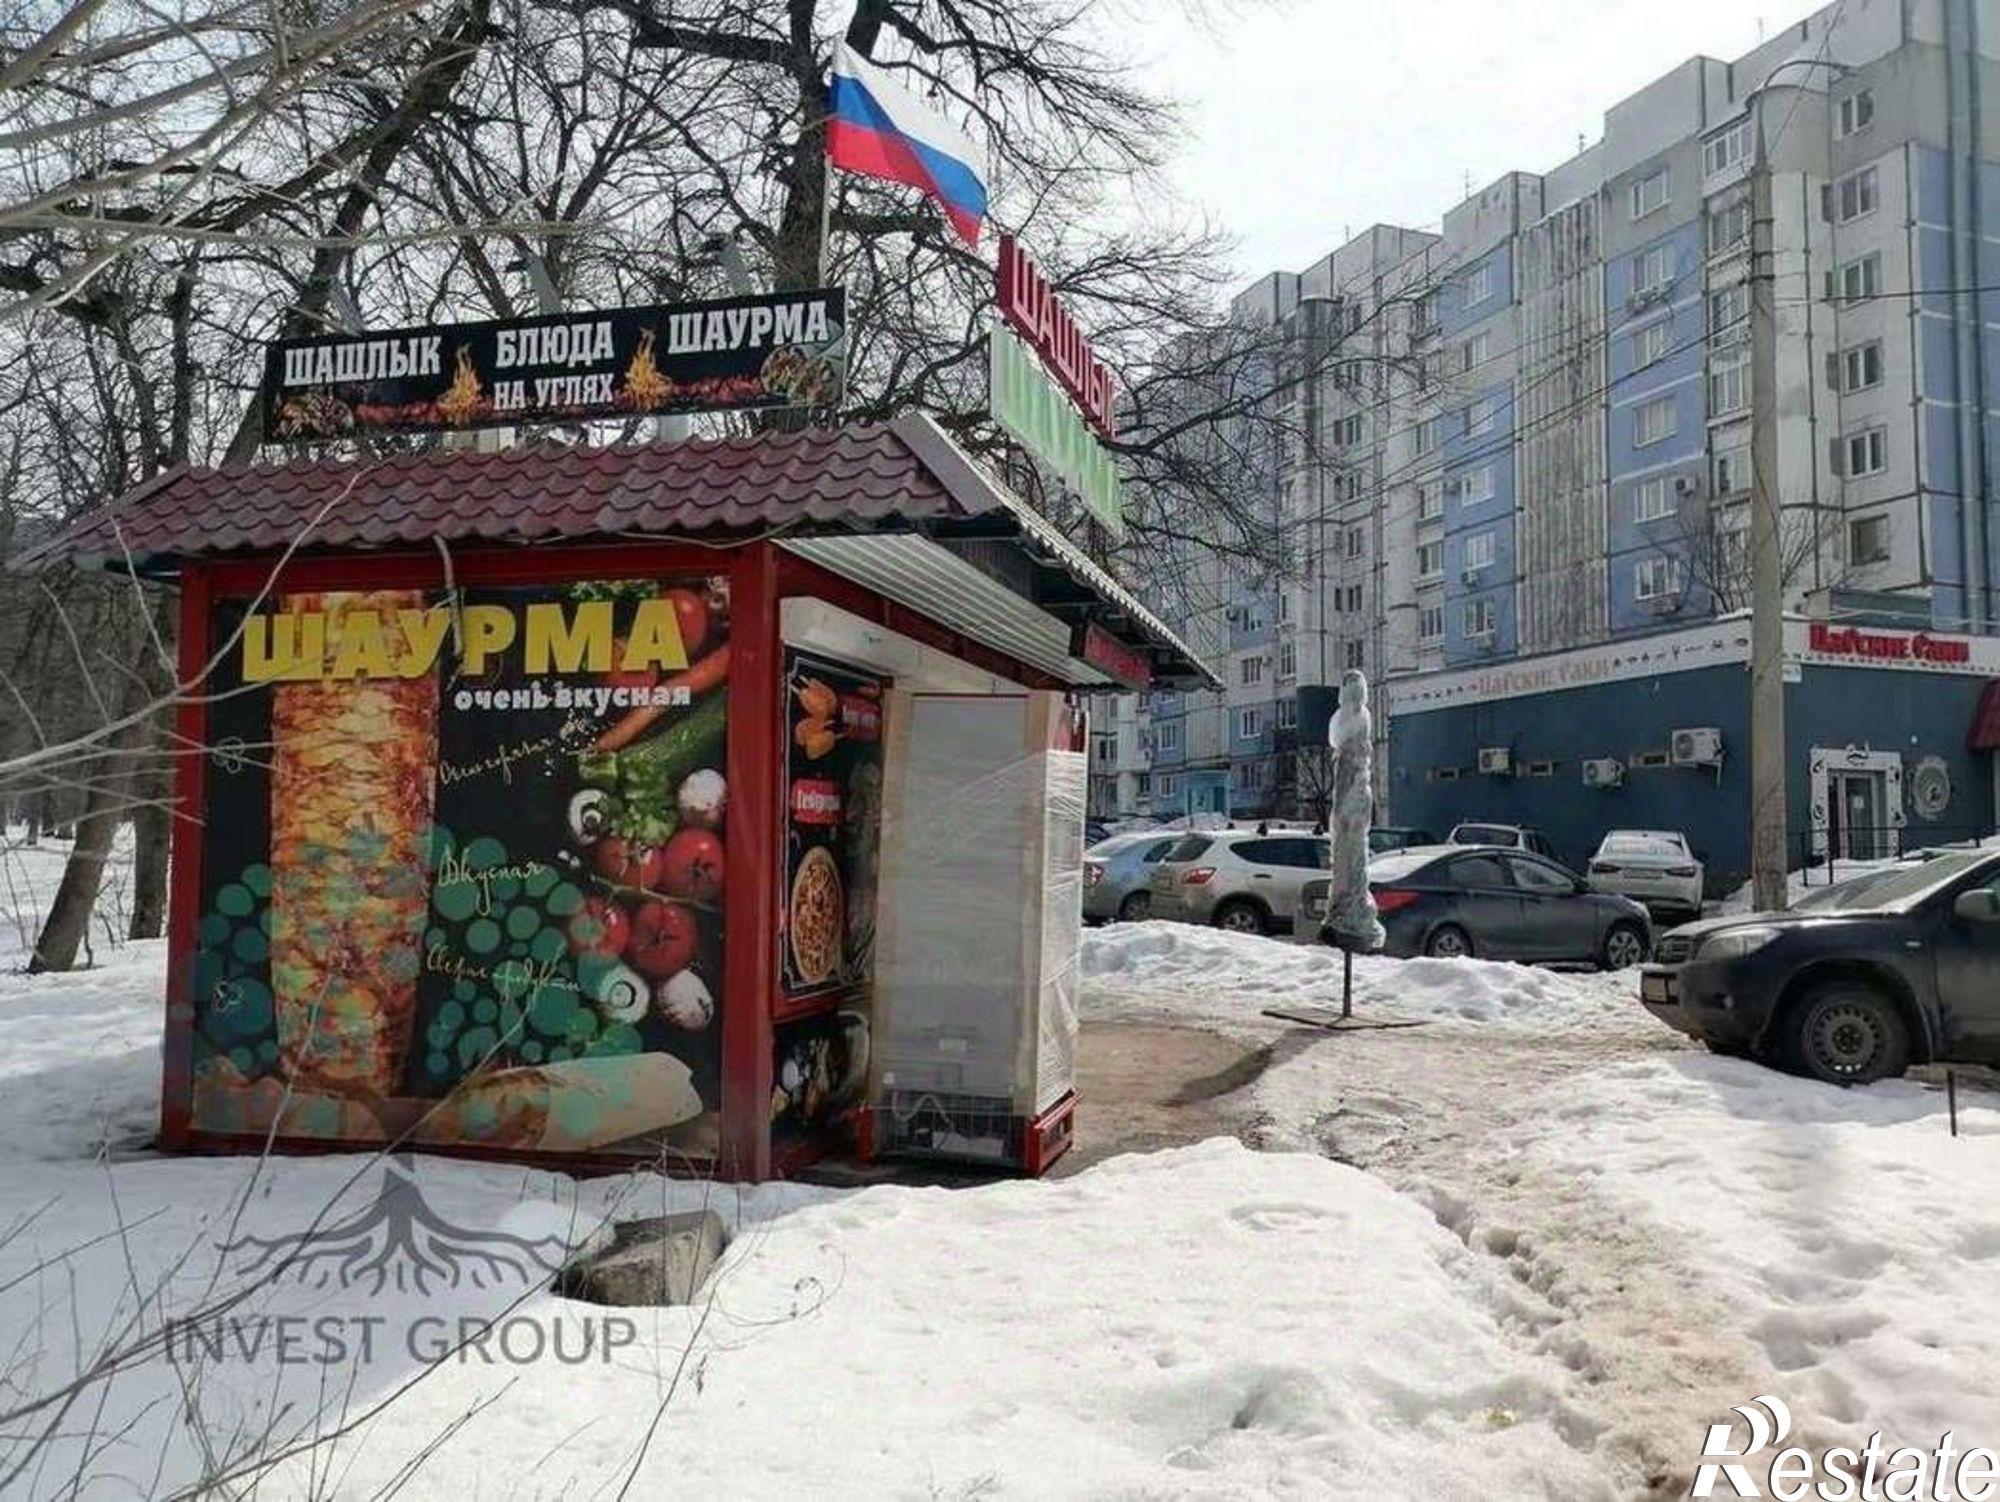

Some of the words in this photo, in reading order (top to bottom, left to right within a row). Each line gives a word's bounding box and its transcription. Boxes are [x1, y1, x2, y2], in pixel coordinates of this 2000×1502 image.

[495, 320, 615, 369] БЛЮДА
[667, 300, 830, 355] ШАУРМА
[284, 335, 442, 386] ШАШЛЫК
[493, 379, 528, 410] НА
[535, 370, 616, 408] УГЛЯХ
[242, 599, 690, 682] ШАУРМА
[454, 680, 550, 711] очень
[552, 681, 691, 717] вкусная
